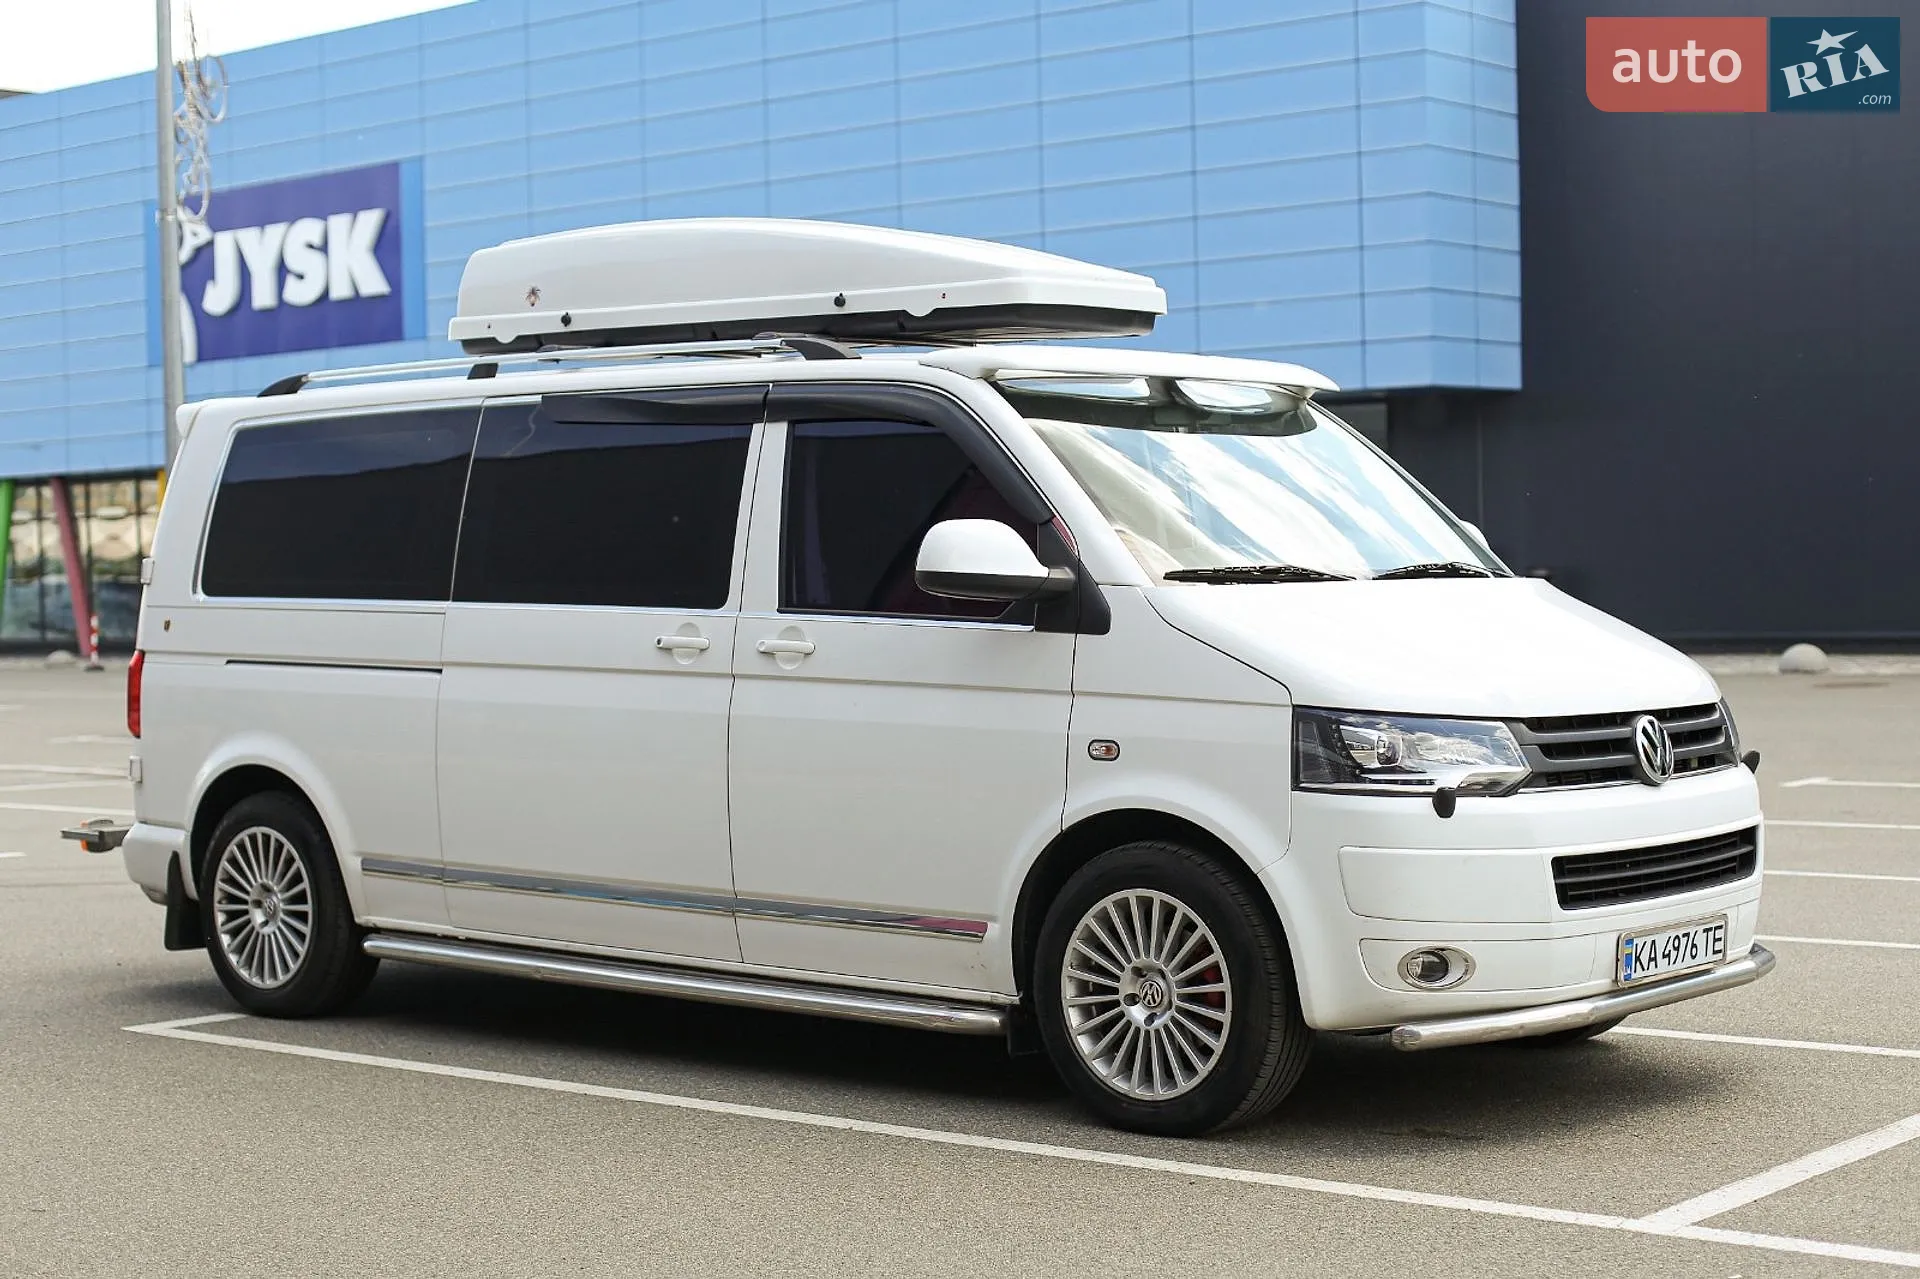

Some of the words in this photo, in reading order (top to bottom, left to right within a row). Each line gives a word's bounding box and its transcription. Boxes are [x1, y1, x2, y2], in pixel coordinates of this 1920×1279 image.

[201, 207, 392, 317] JYSK
[1634, 939, 1658, 974] KA
[1661, 930, 1698, 966] 4976
[1702, 924, 1724, 957] TE
